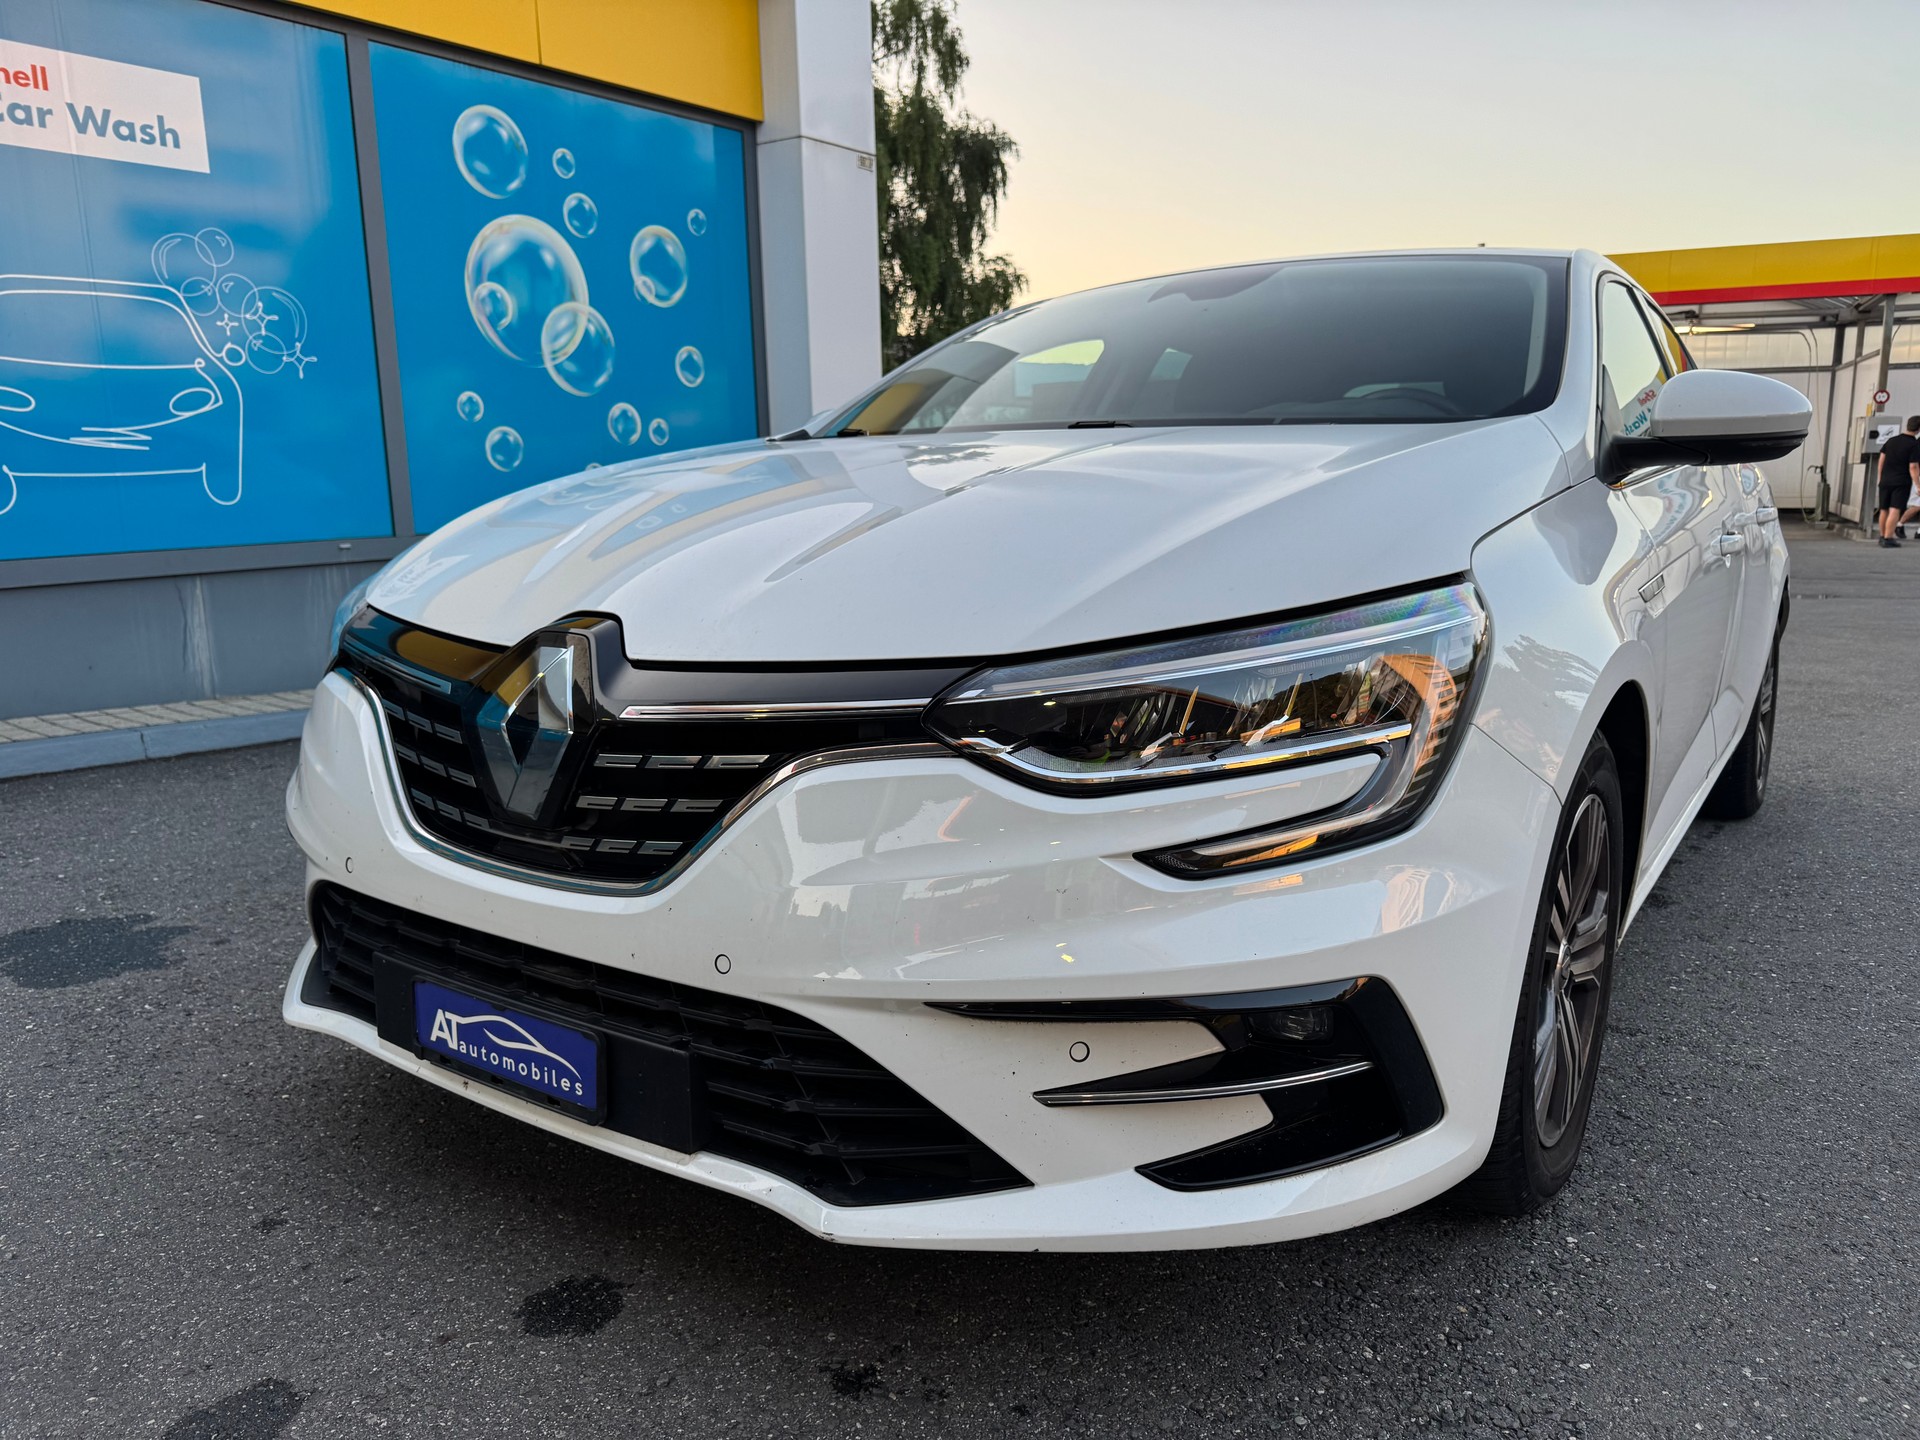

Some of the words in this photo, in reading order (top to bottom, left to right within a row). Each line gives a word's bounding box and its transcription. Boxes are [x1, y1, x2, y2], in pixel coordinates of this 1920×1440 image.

[0, 92, 53, 129] ar
[65, 102, 181, 149] Wash
[430, 1008, 461, 1051] AT
[458, 1039, 583, 1096] automobiles
